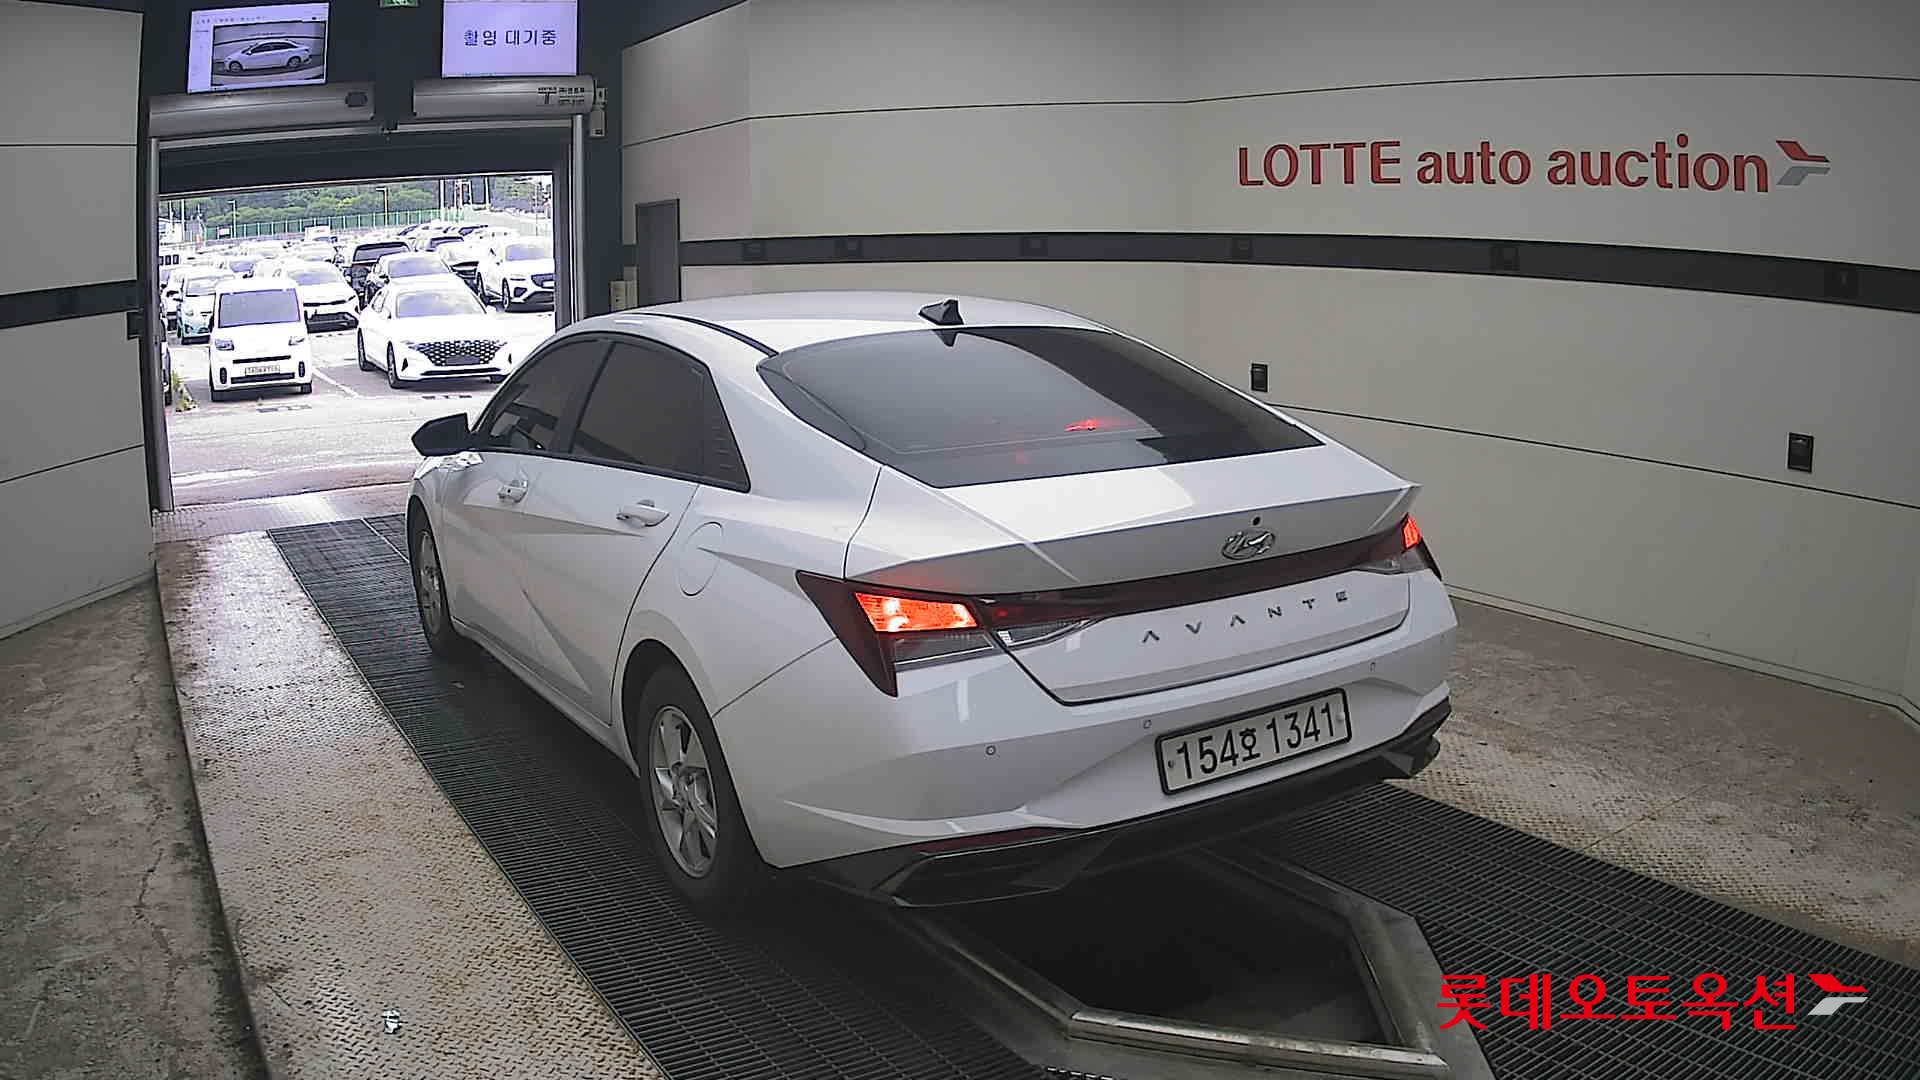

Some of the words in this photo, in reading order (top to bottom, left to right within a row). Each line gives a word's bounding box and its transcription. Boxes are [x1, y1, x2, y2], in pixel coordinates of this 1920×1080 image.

[505, 30, 557, 46] 대기중
[1238, 141, 1400, 187] LOTTE
[1416, 140, 1531, 185] auto
[1547, 134, 1769, 192] auction
[1141, 590, 1349, 644] AVANTE
[1176, 727, 1261, 780] 154호
[1266, 701, 1335, 754] 1341
